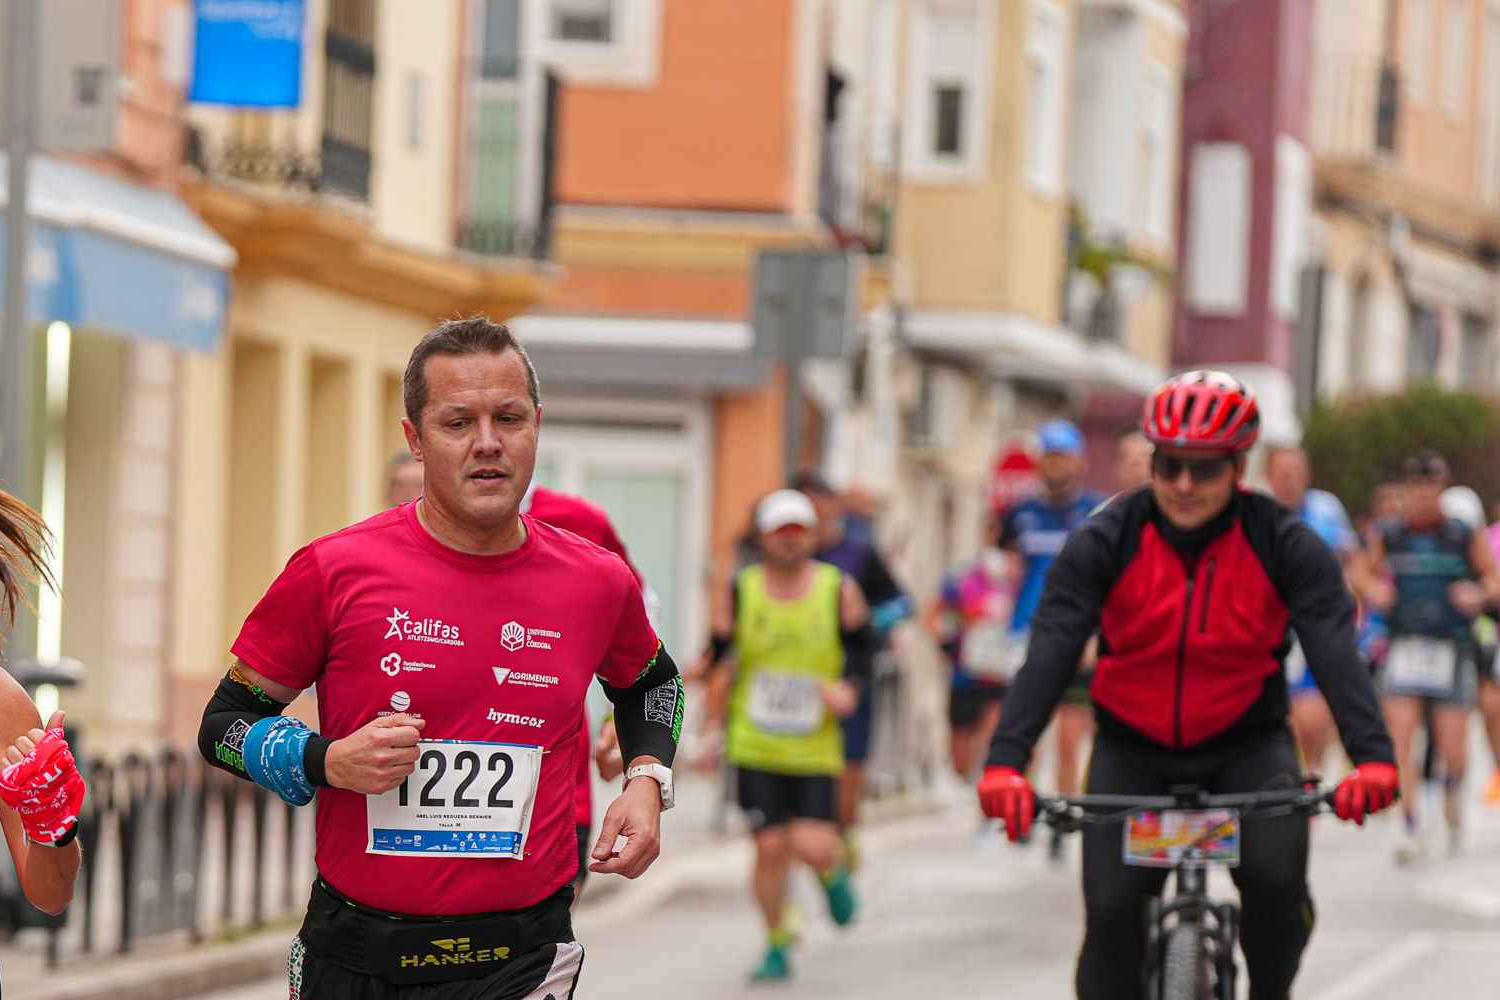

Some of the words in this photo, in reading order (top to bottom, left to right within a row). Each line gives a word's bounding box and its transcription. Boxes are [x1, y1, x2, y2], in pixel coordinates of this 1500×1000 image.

[403, 618, 460, 640] califas
[508, 671, 559, 684] AGRIMENSUR
[486, 707, 546, 729] hymcor
[400, 946, 510, 968] HANKER
